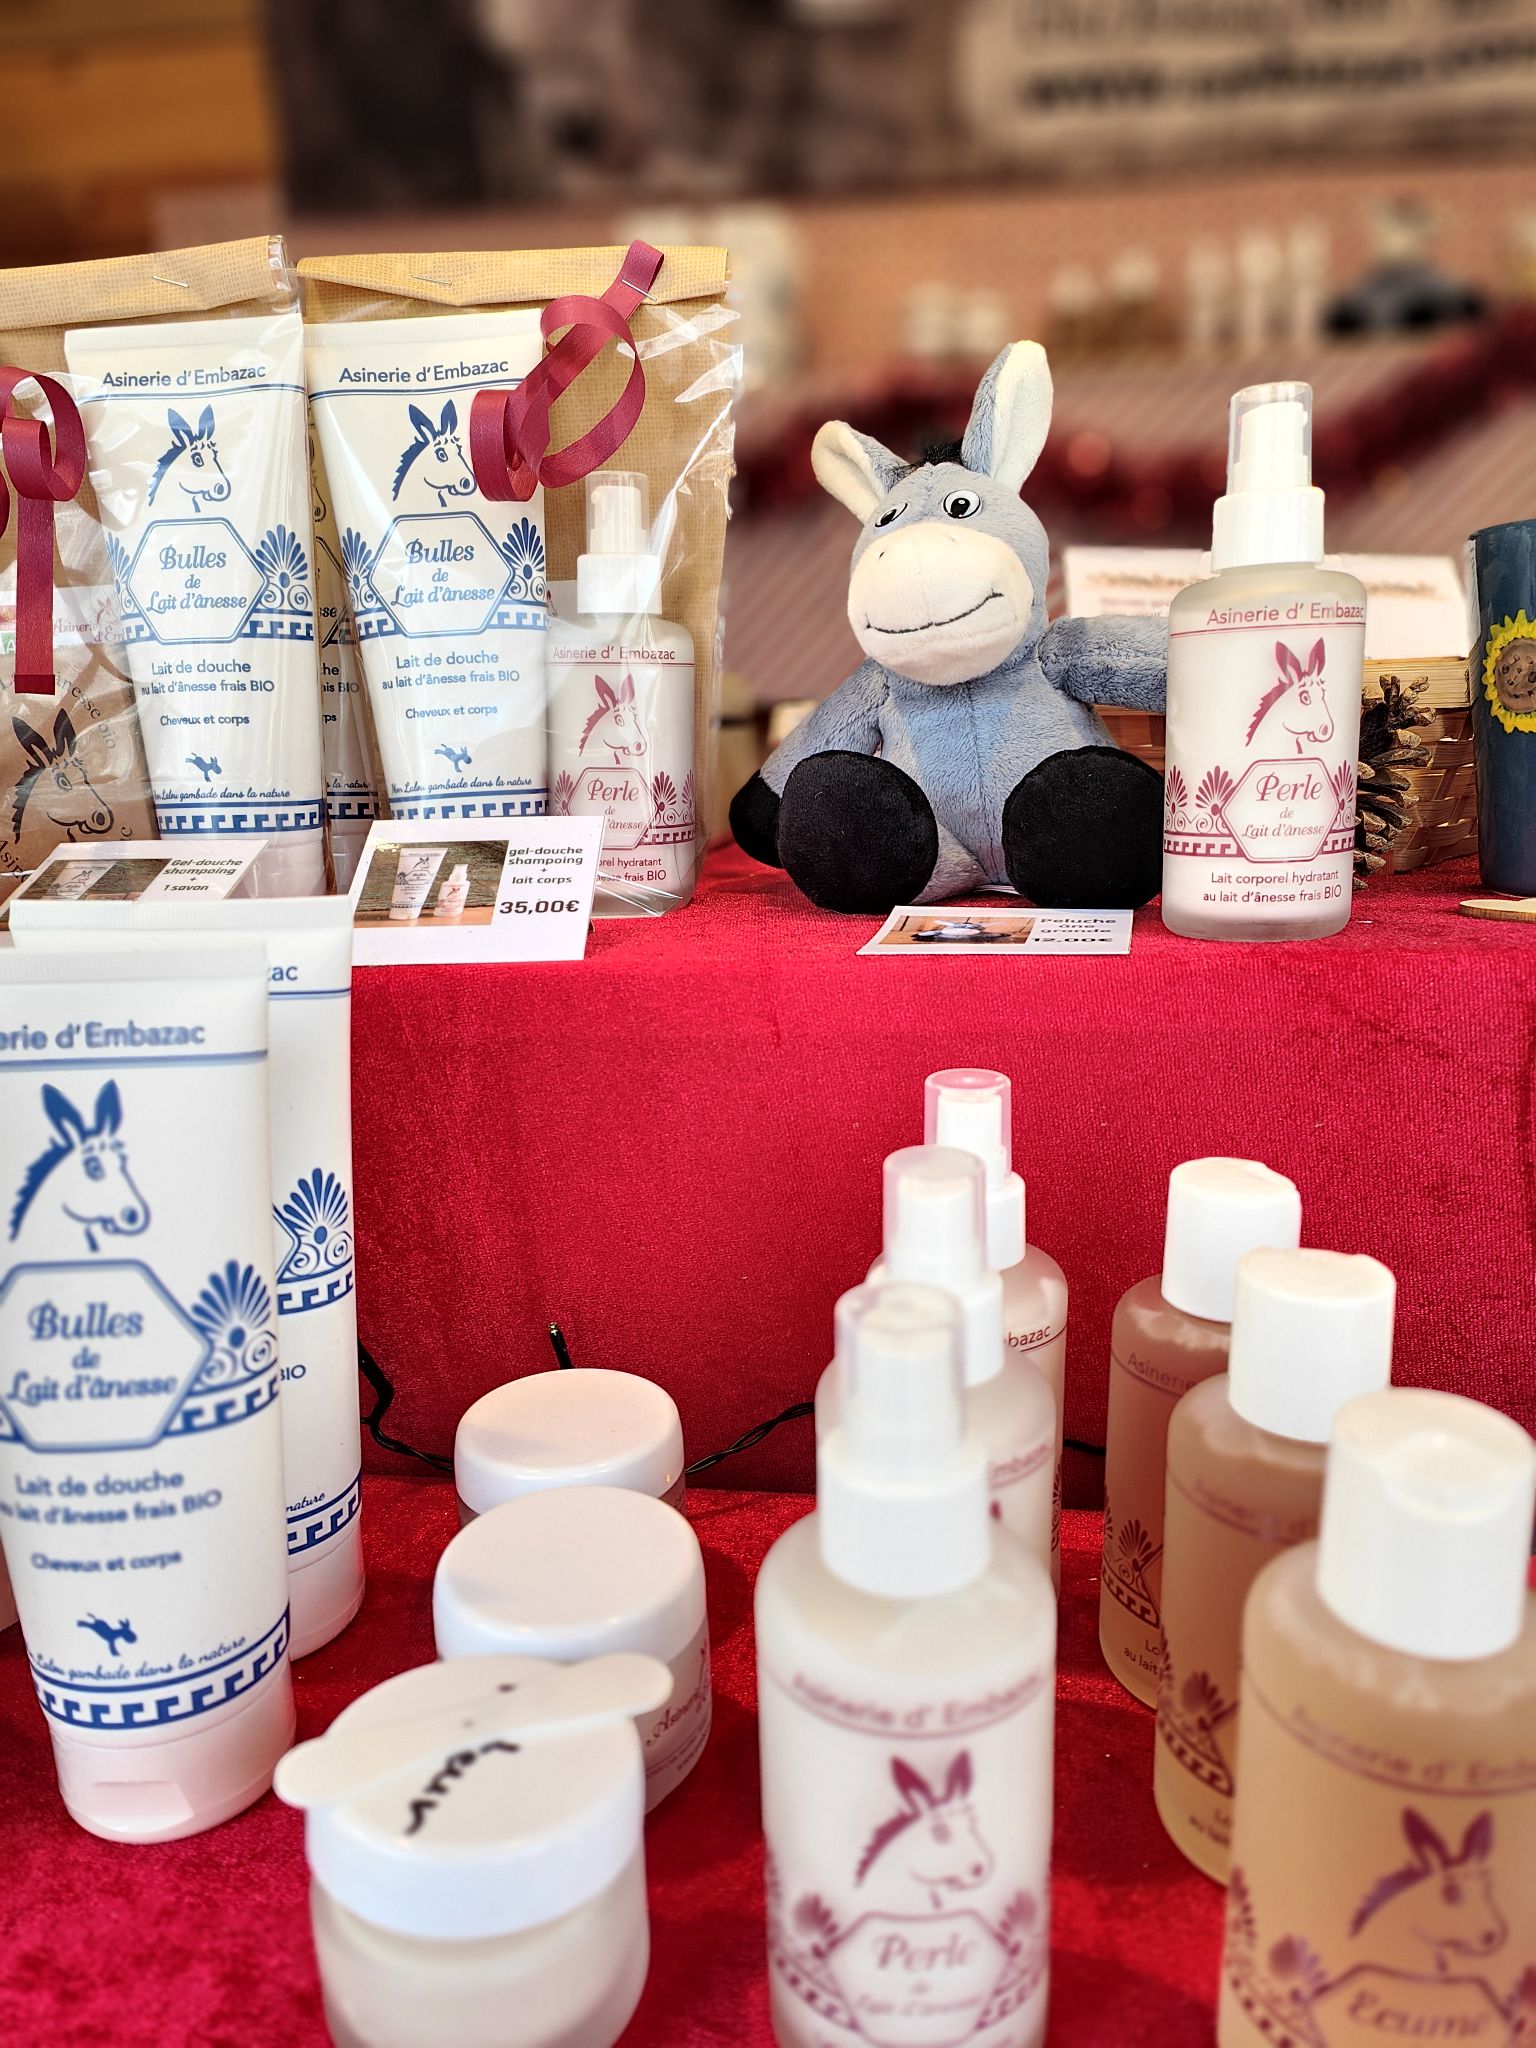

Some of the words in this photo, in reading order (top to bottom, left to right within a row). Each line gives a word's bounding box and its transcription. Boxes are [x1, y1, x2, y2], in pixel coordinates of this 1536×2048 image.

[102, 371, 171, 386] Asinerie
[176, 366, 266, 386] d'Embazac
[339, 367, 411, 383] Asinerie
[416, 360, 509, 381] d'Embazac
[159, 544, 227, 570] Bulles
[405, 538, 474, 564] Bulles
[185, 574, 201, 588] de
[431, 567, 449, 582] de
[146, 591, 177, 614] Lait
[180, 593, 247, 609] d'ânesse
[391, 585, 424, 608] Lait
[428, 586, 495, 603] d'ânesse
[1206, 605, 1279, 626] Asinerie
[1310, 601, 1364, 619] Embazac
[396, 654, 420, 669] Lait
[424, 653, 441, 667] de
[446, 650, 499, 665] douche
[554, 645, 597, 659] Asinerie
[620, 645, 675, 660] Embazac
[151, 661, 173, 675] Lait
[175, 660, 193, 674] de
[196, 659, 252, 674] douche
[141, 686, 150, 695] au
[151, 682, 166, 694] lait
[168, 680, 217, 693] d'ânesse
[220, 679, 247, 692] frais
[250, 680, 275, 692] BIO
[382, 680, 393, 689] au
[395, 676, 412, 688] lait
[415, 673, 466, 686] d'ânesse
[469, 670, 495, 683] frais
[498, 670, 520, 682] BIO
[406, 707, 450, 719] Cheveux
[454, 706, 465, 715] et
[468, 705, 498, 717] corps
[160, 715, 201, 726] Cheveux
[203, 715, 214, 724] et
[218, 715, 250, 727] corps
[428, 777, 468, 793] gambade
[470, 776, 493, 788] dans
[496, 776, 505, 786] la
[507, 776, 532, 786] nature
[587, 778, 639, 801] Perle
[1256, 772, 1323, 801] Perle
[180, 787, 218, 802] gambade
[220, 787, 244, 798] dans
[247, 787, 257, 798] la
[259, 788, 290, 798] nature
[605, 806, 616, 815] de
[1279, 807, 1294, 819] de
[1242, 824, 1269, 839] Lait
[1272, 824, 1325, 837] d'ânesse
[508, 847, 583, 857] gel-douche
[508, 856, 584, 866] shampoing
[617, 857, 662, 868] hydratant
[163, 867, 237, 876] shampoing
[624, 872, 644, 882] frais
[647, 869, 667, 881] BIO
[1211, 872, 1232, 883] Lait
[1236, 871, 1288, 886] corporel
[1292, 870, 1339, 886] hydratant
[512, 876, 535, 884] lait
[537, 876, 573, 885] corps
[1203, 892, 1216, 902] au
[1220, 890, 1238, 902] lait
[1242, 890, 1296, 903] d'ânesse
[1299, 889, 1322, 901] frais
[1324, 885, 1342, 900] BIO
[499, 900, 579, 915] 35,00€
[0, 1024, 48, 1050] erie
[55, 1019, 205, 1049] d'Embazac
[28, 1299, 144, 1341] Bulles
[1008, 1325, 1051, 1348] bazac
[72, 1346, 101, 1370] de
[7, 1370, 59, 1407] Lait
[65, 1374, 178, 1401] d'ânesse
[15, 1473, 53, 1496] Lait
[57, 1475, 88, 1497] de
[94, 1470, 185, 1496] douche
[45, 1507, 128, 1525] d'ânesse
[133, 1501, 177, 1520] frais
[182, 1489, 223, 1514] BIO
[31, 1552, 101, 1572] Cheveux
[106, 1557, 125, 1571] et
[130, 1550, 182, 1570] corps
[68, 1664, 130, 1682] gambade
[135, 1661, 172, 1678] dans
[178, 1653, 194, 1670] la
[198, 1636, 246, 1663] nature
[1123, 1646, 1137, 1663] au
